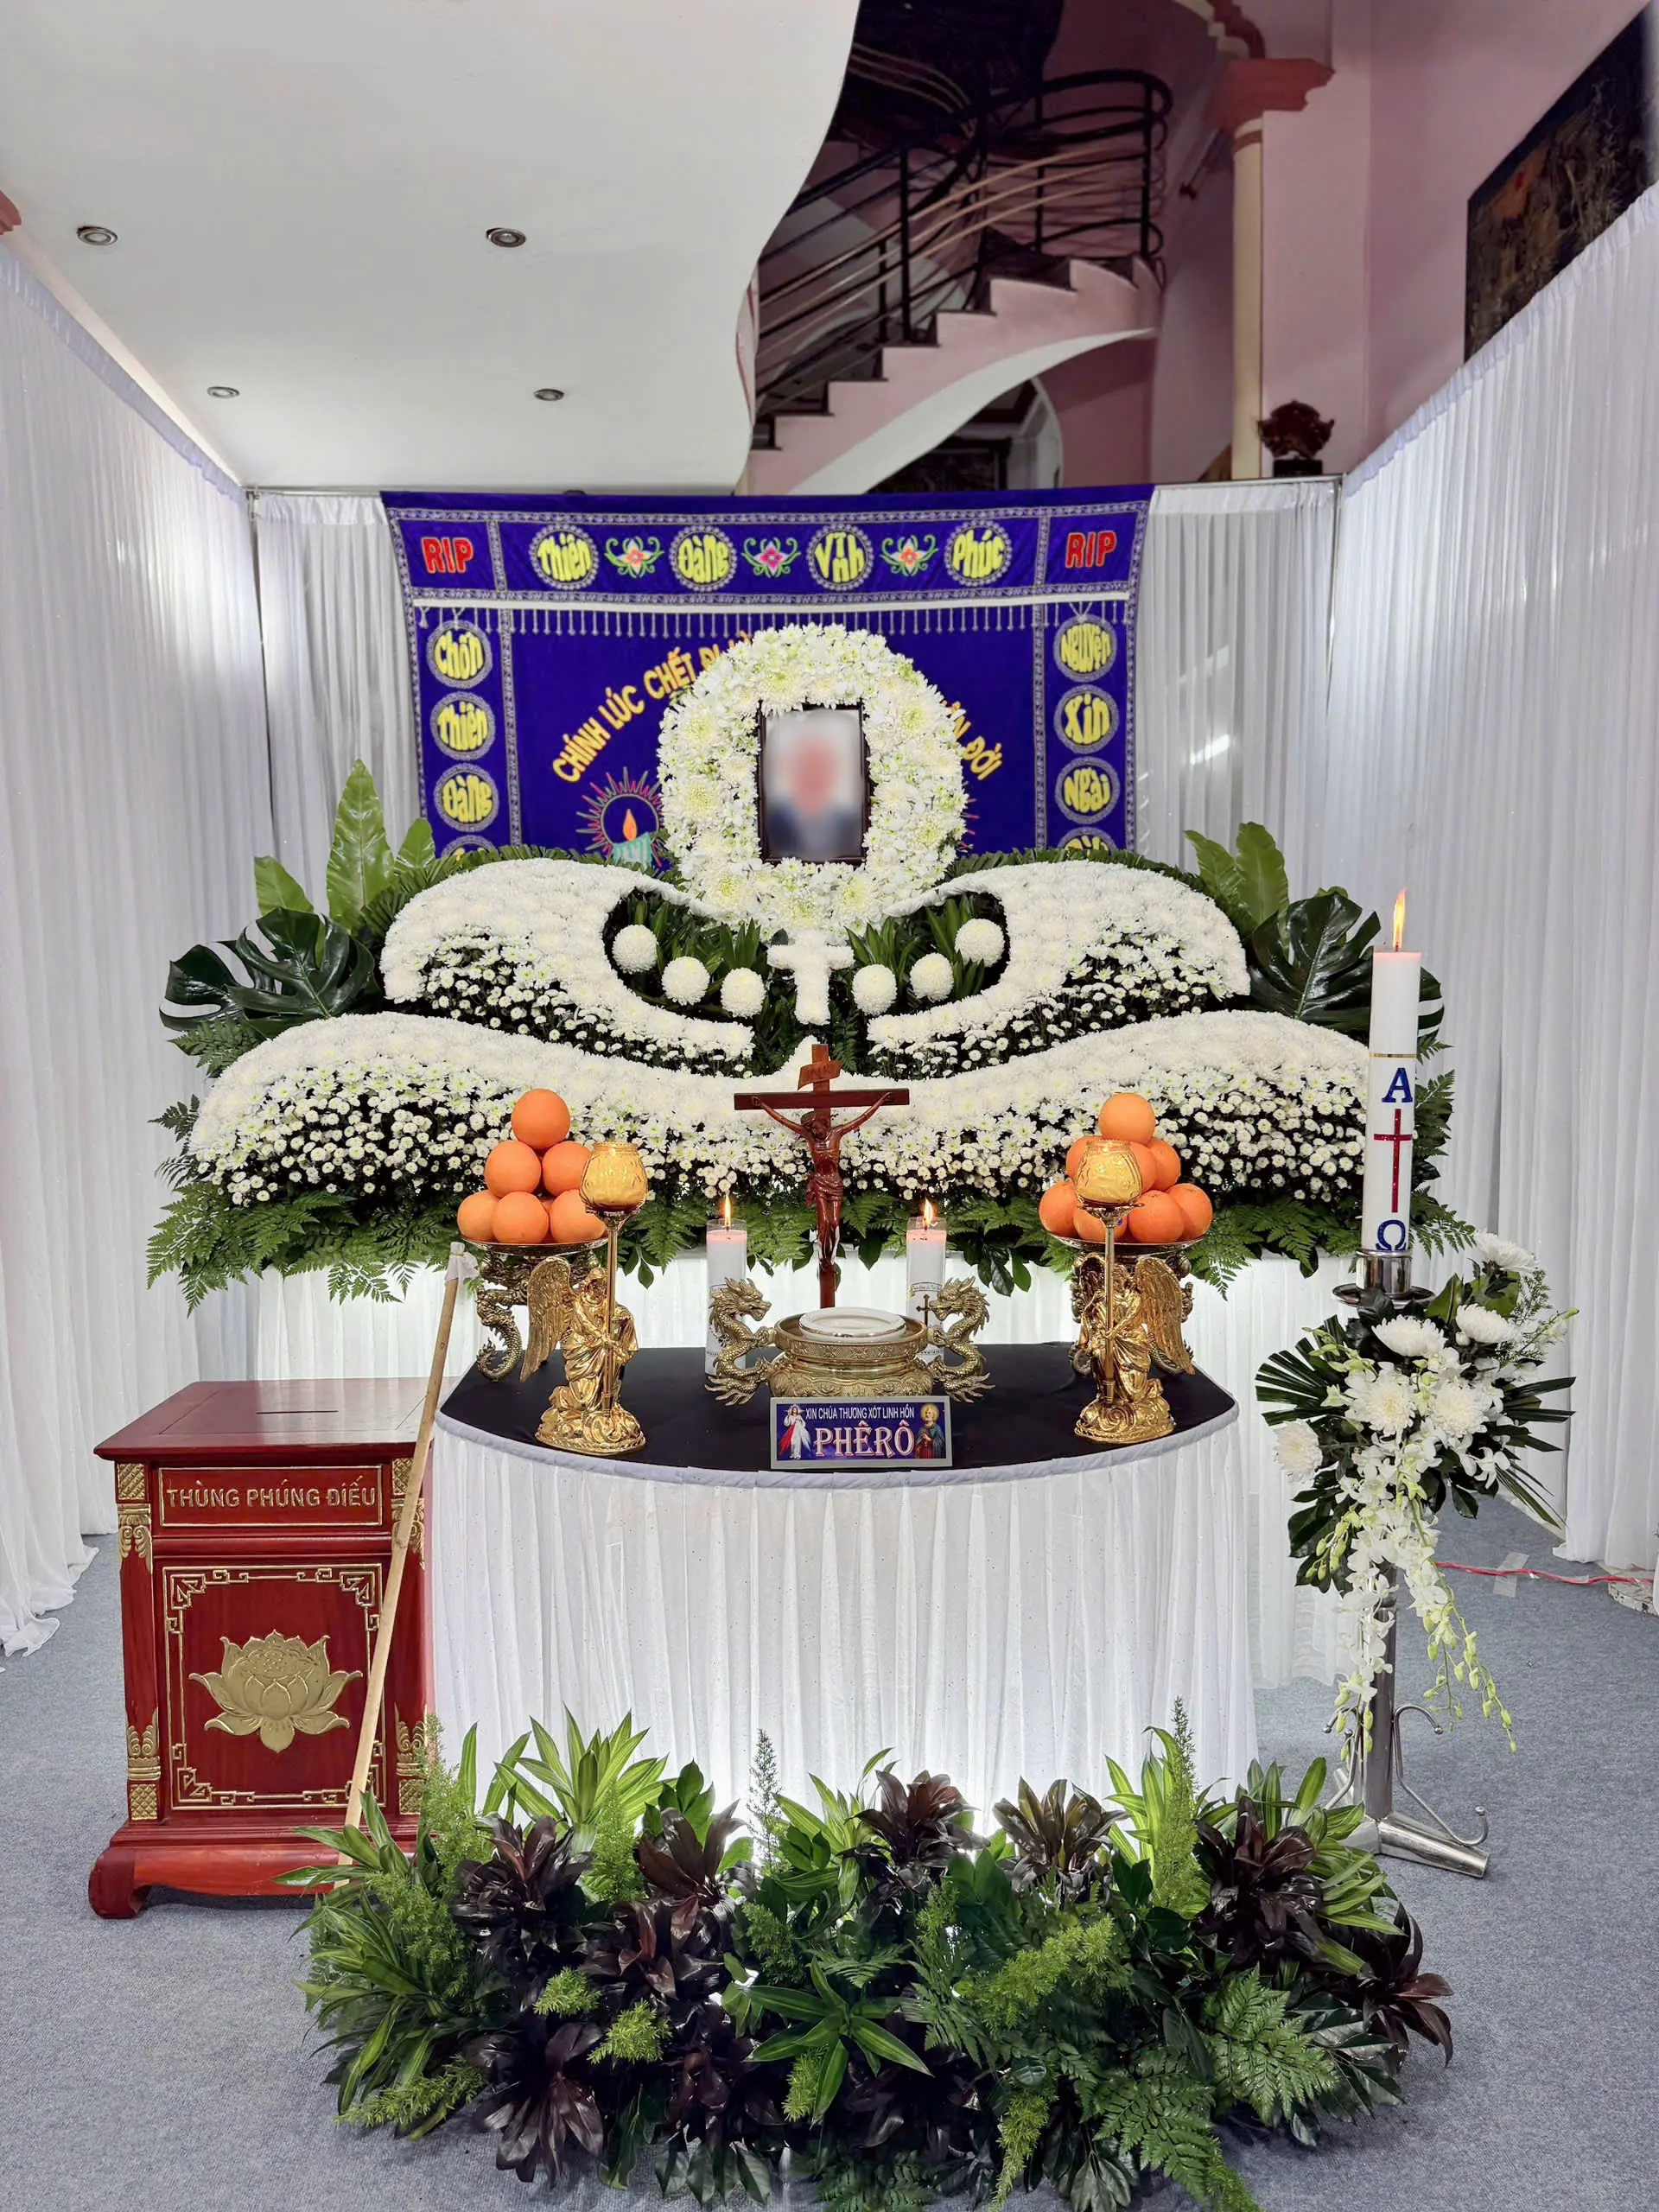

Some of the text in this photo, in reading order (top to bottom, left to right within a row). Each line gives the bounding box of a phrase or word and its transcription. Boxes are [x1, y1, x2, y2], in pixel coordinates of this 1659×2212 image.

[421, 537, 474, 574] RIP
[537, 532, 593, 582] Thiên
[814, 531, 865, 583] Vĩnh
[952, 530, 1005, 579] Phúc
[1065, 531, 1116, 568] RIP
[434, 630, 484, 680] Chốn
[436, 701, 489, 751] Thiên
[552, 716, 612, 783] CHÍNH
[598, 684, 645, 730] LÚC
[643, 646, 696, 700] CHẾT
[963, 735, 1003, 781] ĐỜI
[1065, 692, 1111, 746] Xin
[1064, 767, 1111, 814] Ngài
[1382, 1068, 1413, 1103] A
[1376, 1219, 1408, 1251] Ω
[805, 1408, 817, 1421] XIN
[818, 1406, 838, 1420] CHÚA
[839, 1407, 868, 1420] THƯƠNG
[868, 1405, 882, 1420] XÓT
[882, 1407, 899, 1419] LINH
[813, 1420, 915, 1459] PHÊRÔ
[166, 1479, 240, 1508] THÙNG
[246, 1478, 321, 1508] PHÚNG
